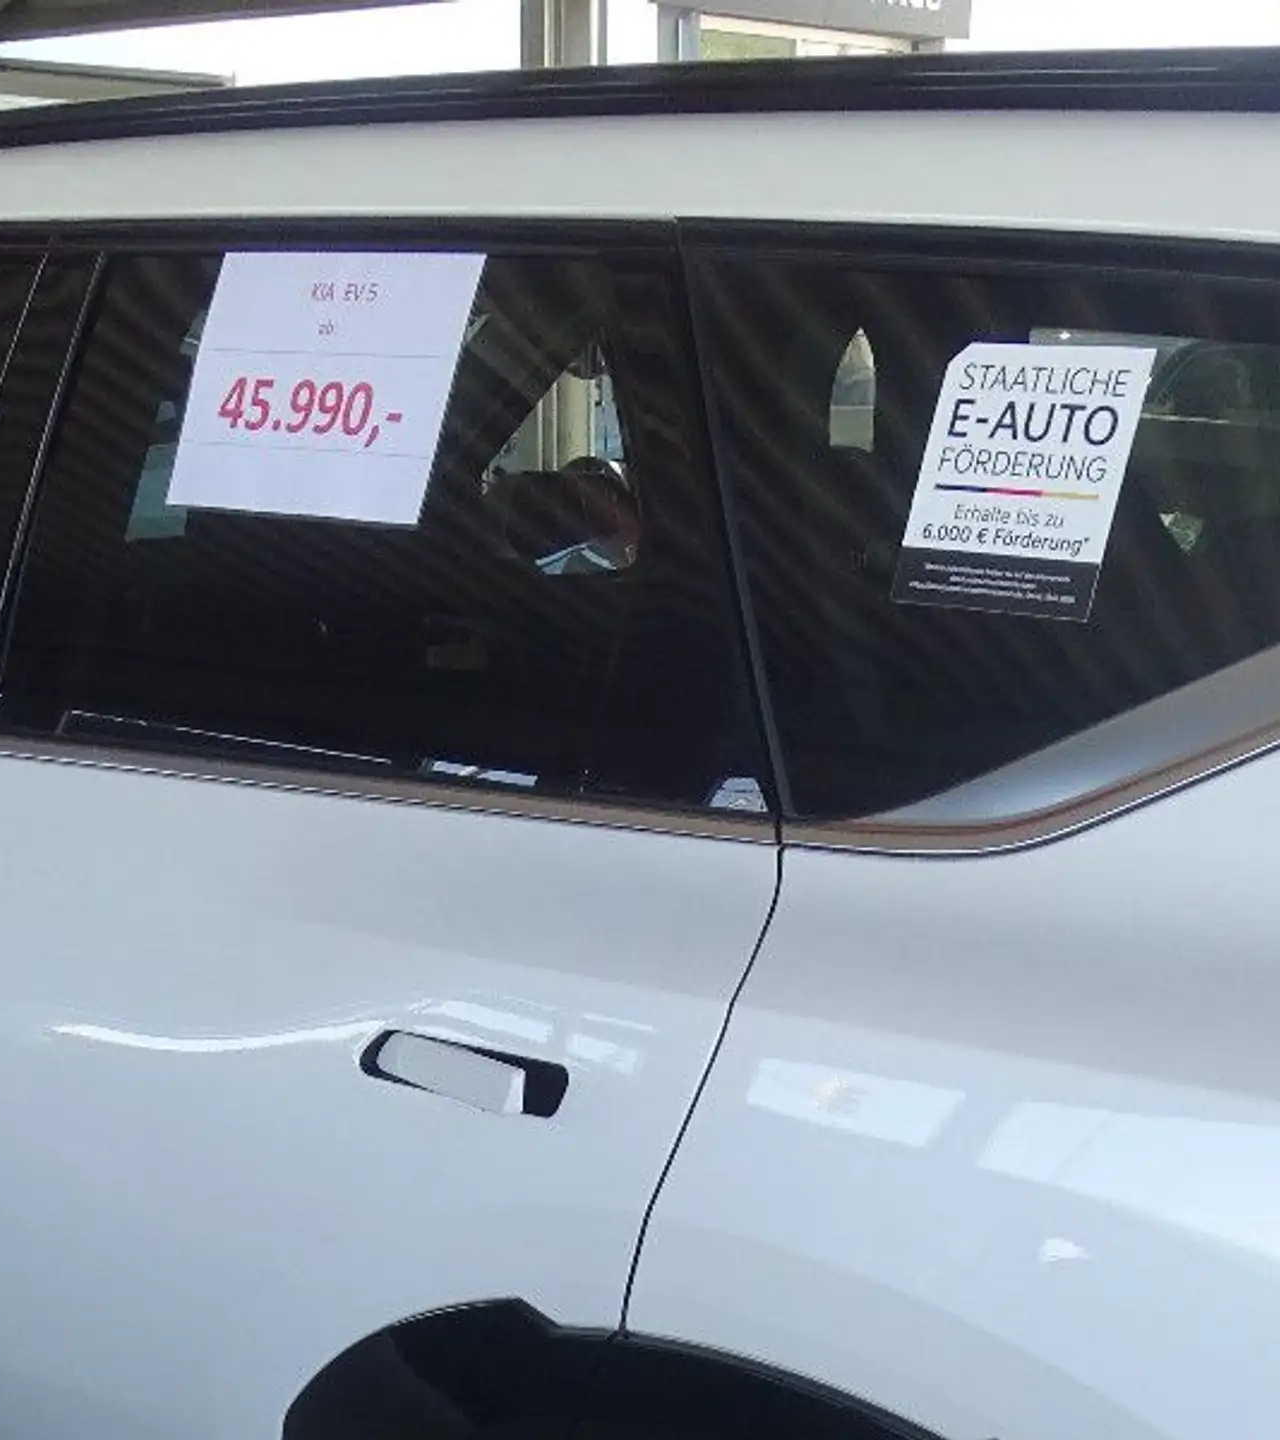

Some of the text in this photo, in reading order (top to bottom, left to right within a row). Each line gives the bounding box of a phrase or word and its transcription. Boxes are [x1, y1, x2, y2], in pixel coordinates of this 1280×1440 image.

[311, 282, 335, 301] KIA
[318, 319, 335, 335] ab
[959, 361, 1132, 398] STAATLICHE
[218, 376, 403, 448] 45.990,-
[947, 398, 1119, 446] E-AUTO
[937, 444, 1108, 484] FÖRDERUNG
[953, 503, 1065, 530] Erhalte bis zu
[922, 523, 972, 544] 6.000
[976, 527, 990, 545] €
